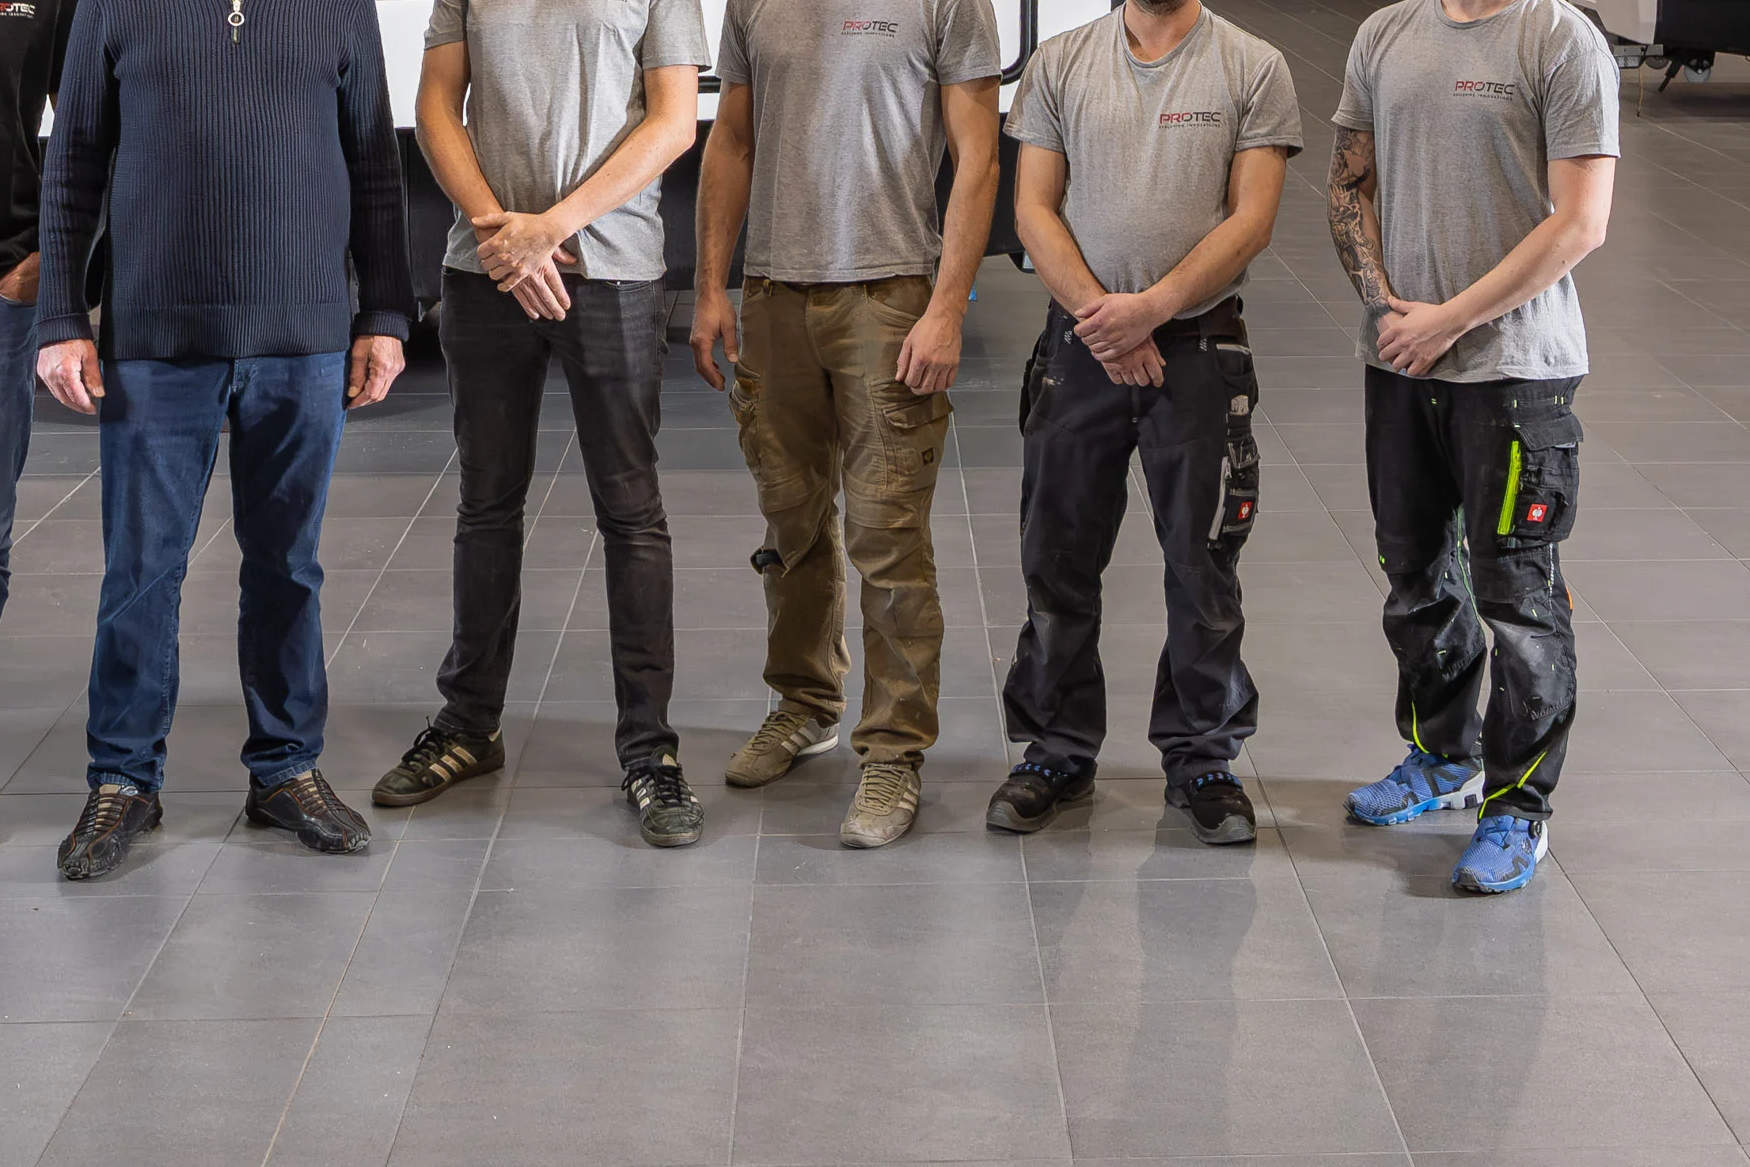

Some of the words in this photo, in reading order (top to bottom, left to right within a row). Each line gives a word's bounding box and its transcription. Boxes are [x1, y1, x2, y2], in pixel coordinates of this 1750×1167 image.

[842, 20, 899, 33] PROTEC
[1454, 80, 1516, 96] PROTEC
[1159, 111, 1222, 125] PROTEC
